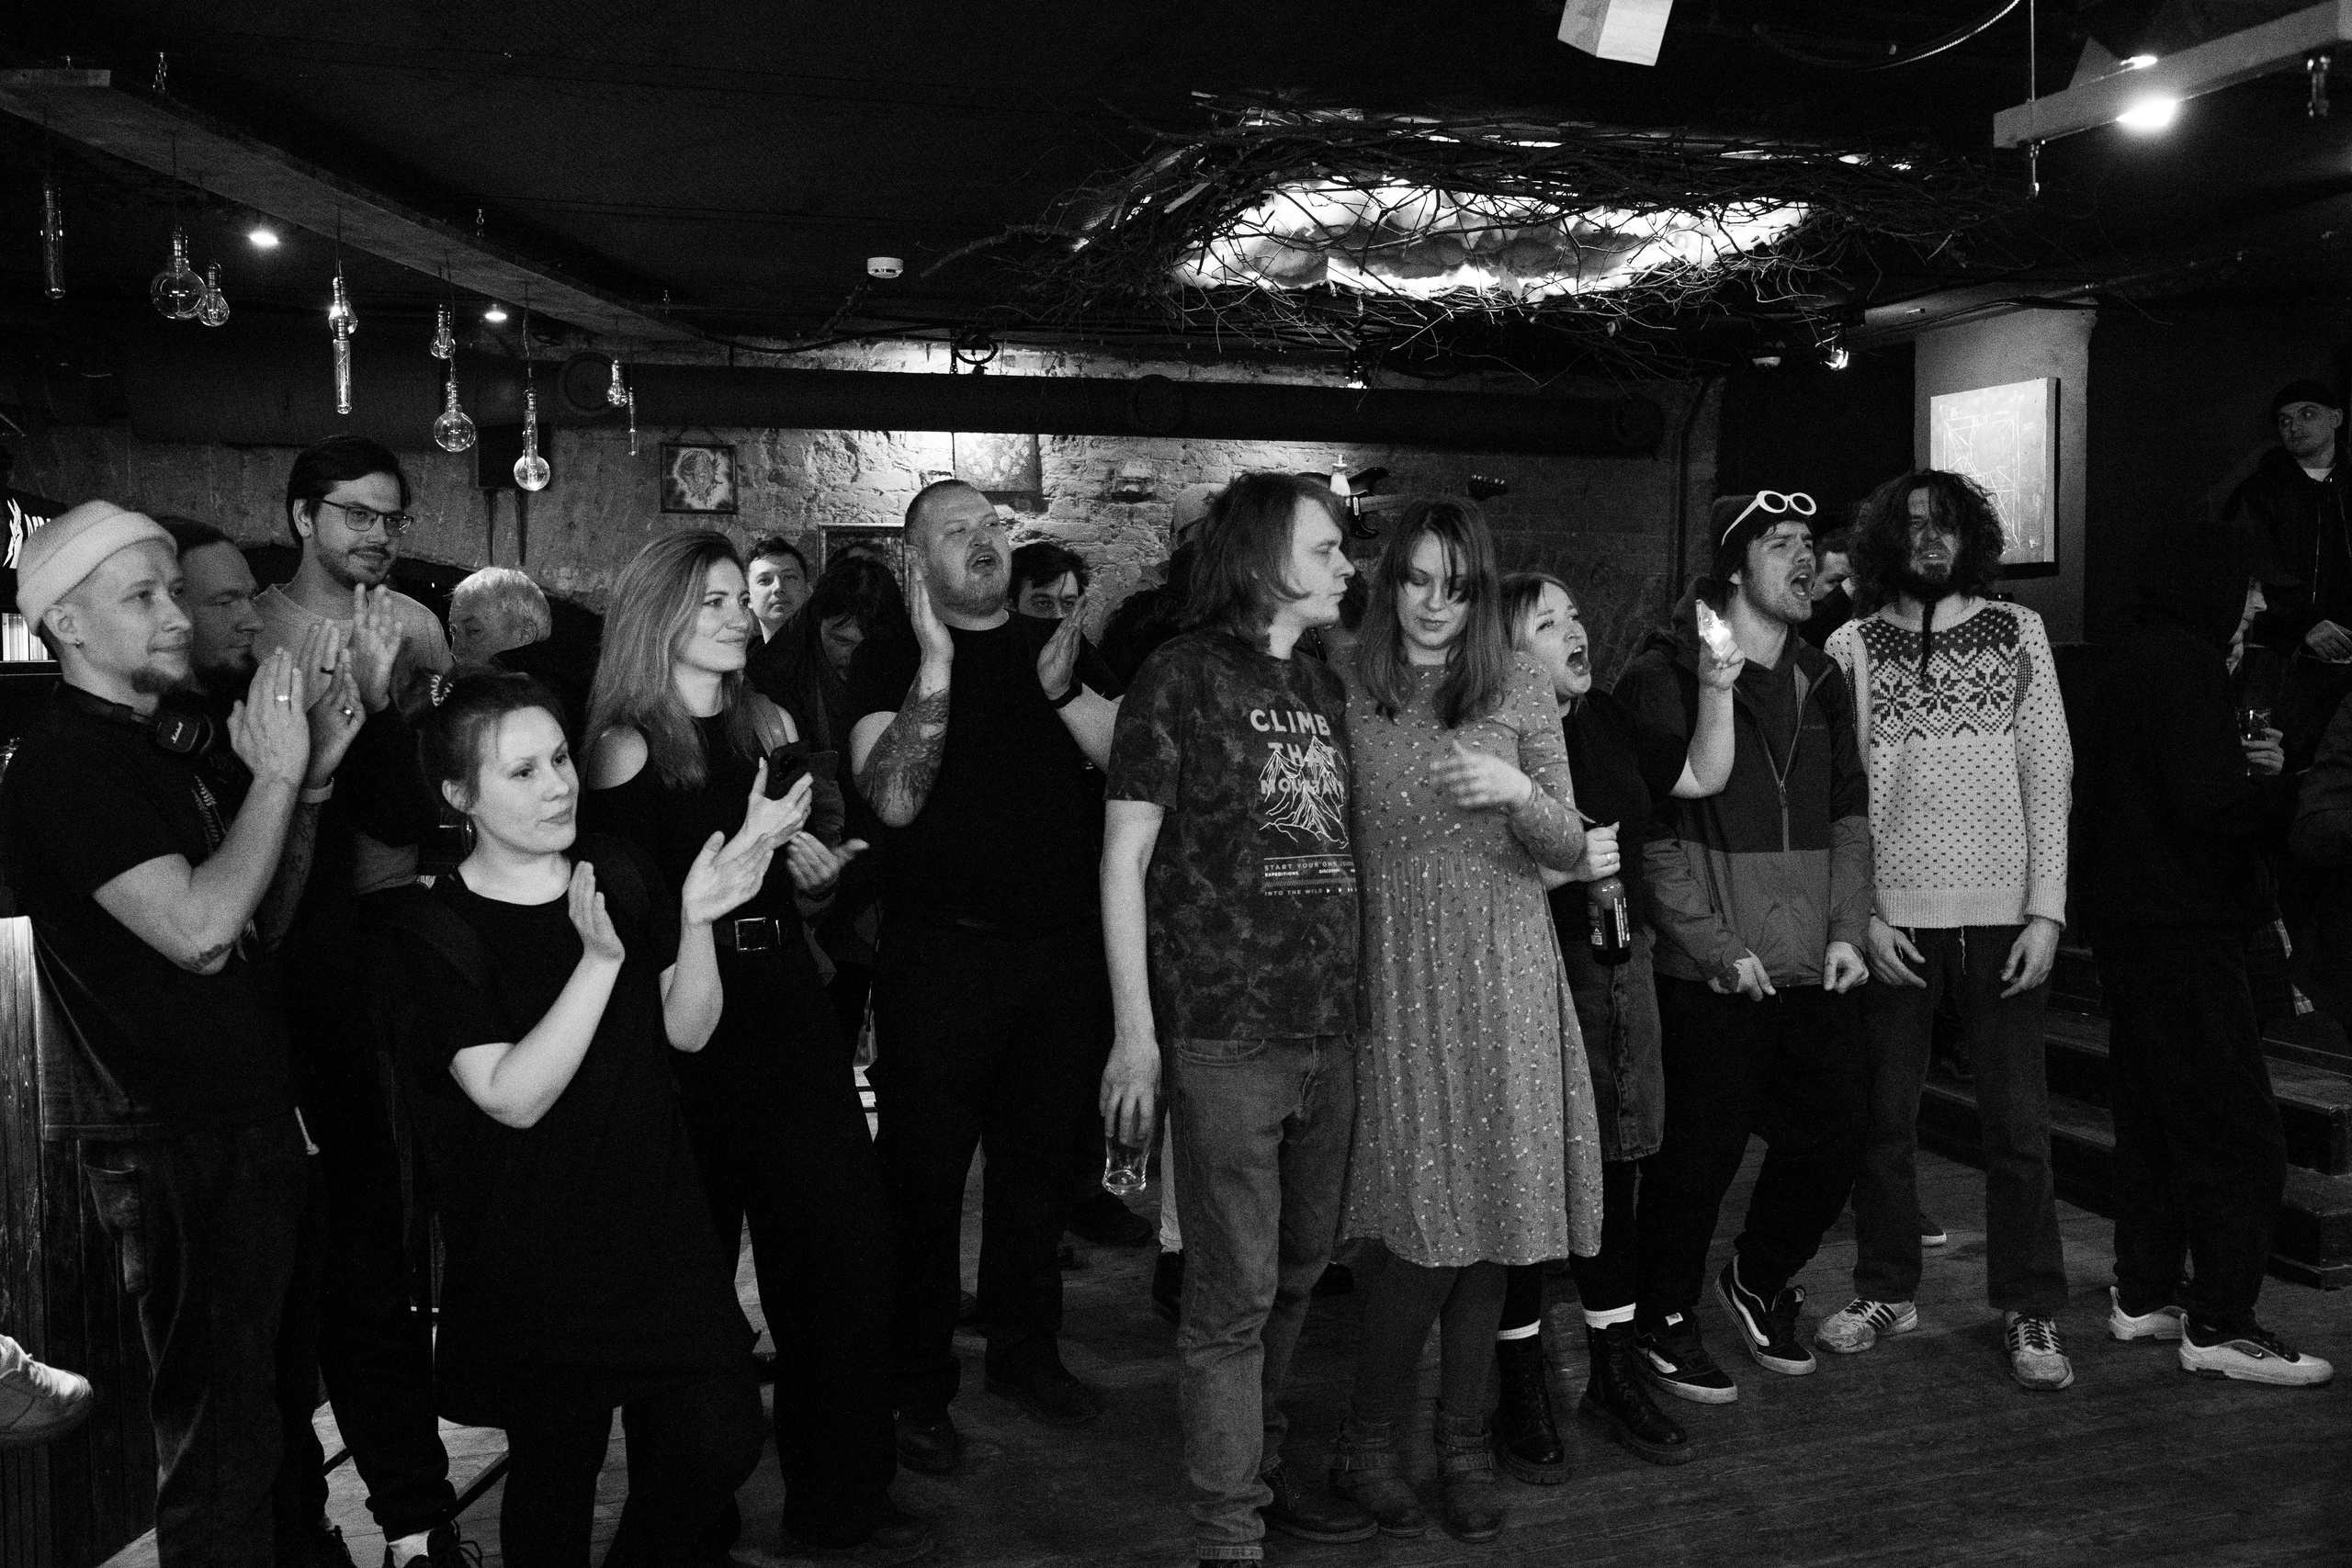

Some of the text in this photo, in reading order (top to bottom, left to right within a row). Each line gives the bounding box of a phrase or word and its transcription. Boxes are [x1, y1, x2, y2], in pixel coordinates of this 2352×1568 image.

[1250, 709, 1330, 736] CLIMB
[1267, 742, 1337, 770] THAT
[1261, 778, 1344, 795] MOUNTAIN
